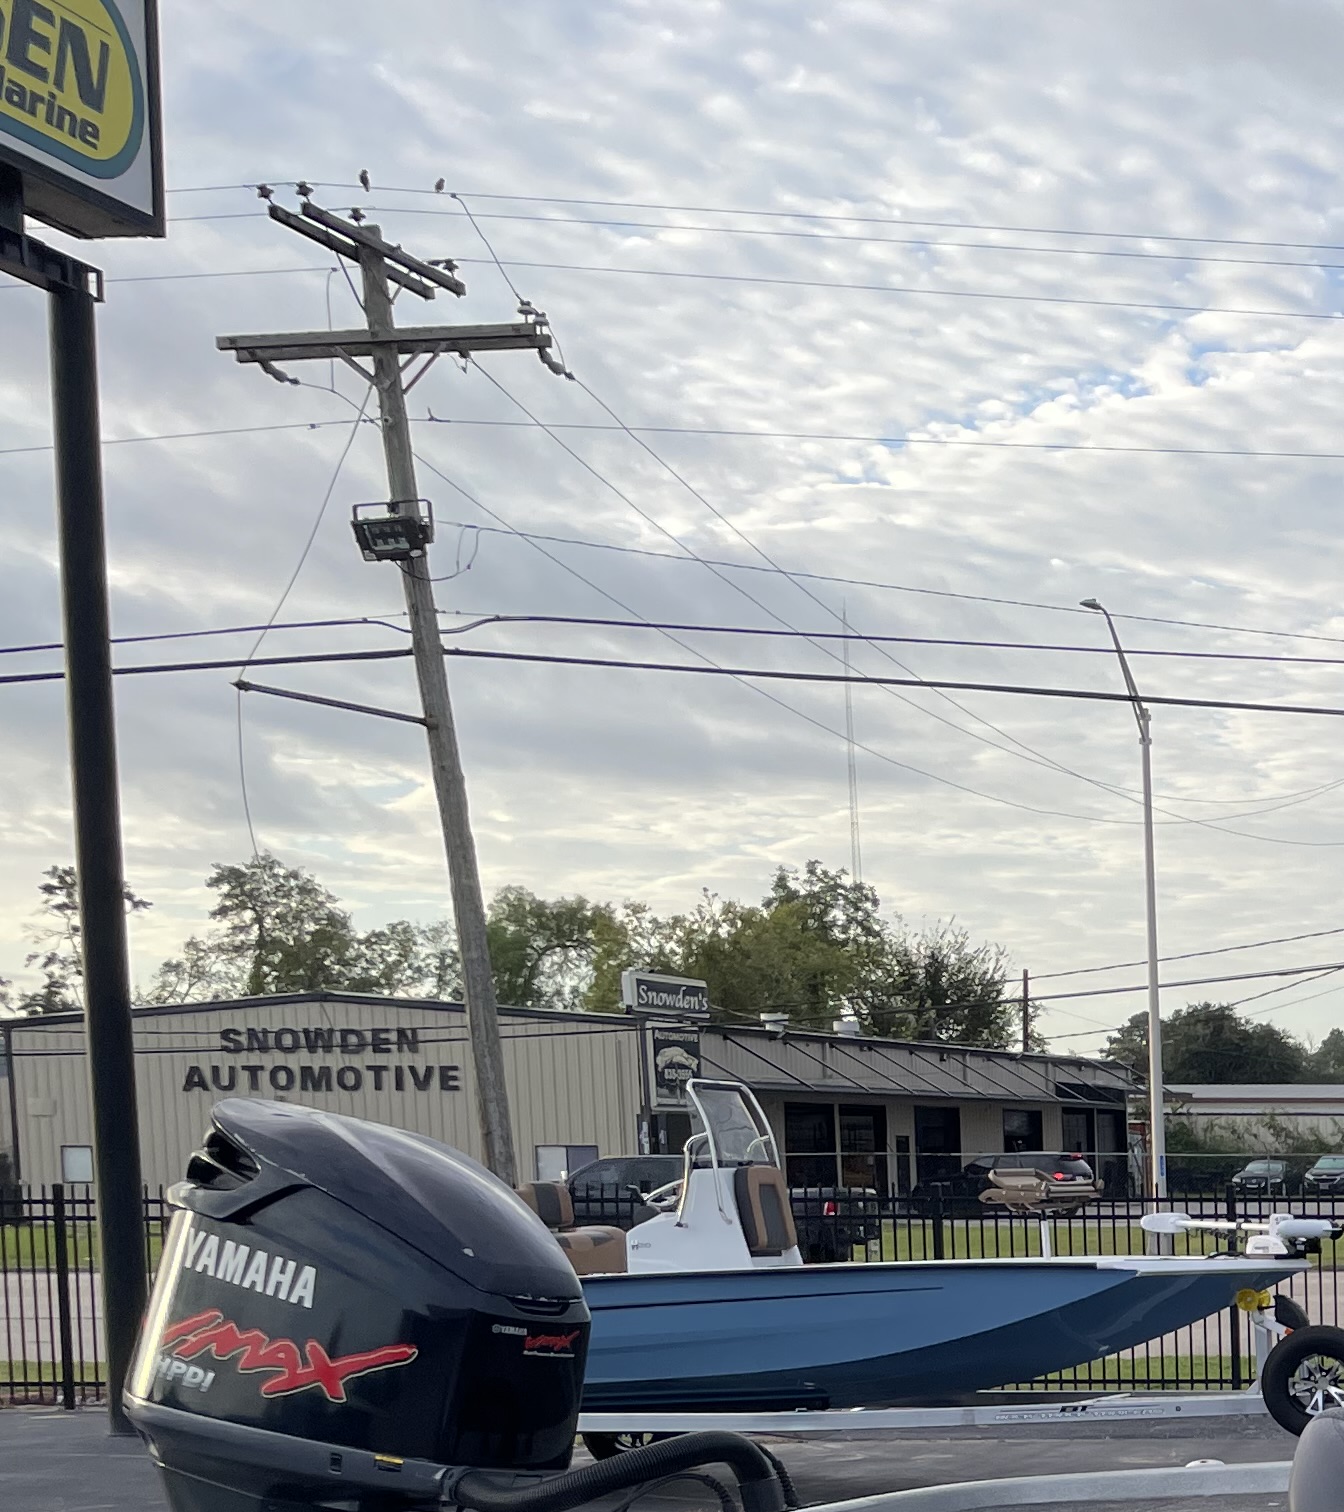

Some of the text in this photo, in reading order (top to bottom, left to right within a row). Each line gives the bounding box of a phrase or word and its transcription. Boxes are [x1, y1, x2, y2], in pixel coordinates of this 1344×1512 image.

[0, 0, 109, 114] EN
[638, 984, 709, 1011] Snowden's
[220, 1026, 420, 1054] SNOWDEN
[653, 1029, 699, 1043] AUTOMOTIVE
[182, 1064, 461, 1092] AUTOMOTIVE
[184, 1227, 317, 1309] YAMAHA
